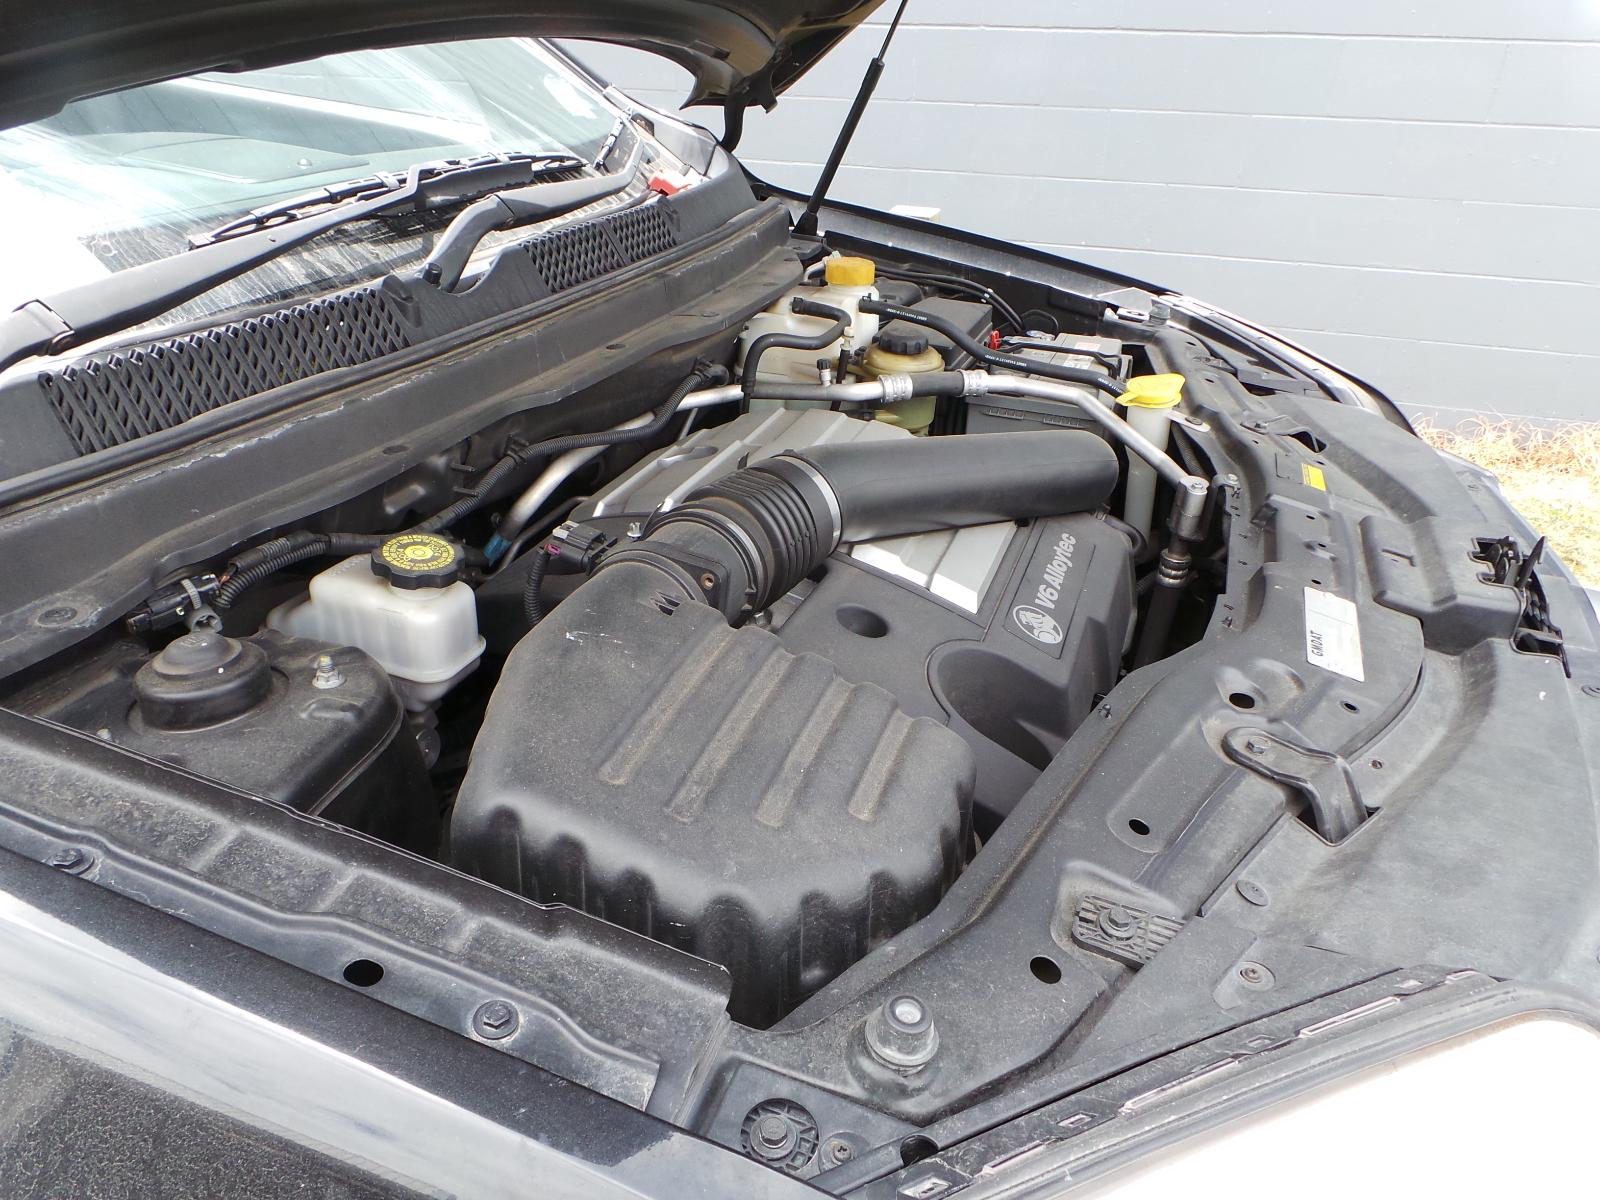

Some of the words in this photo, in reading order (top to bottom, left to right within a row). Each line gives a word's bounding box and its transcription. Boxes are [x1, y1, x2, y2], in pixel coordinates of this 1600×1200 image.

[1043, 532, 1077, 590] Alloytec
[1034, 584, 1059, 609] V6
[1310, 629, 1324, 657] GMDAT
